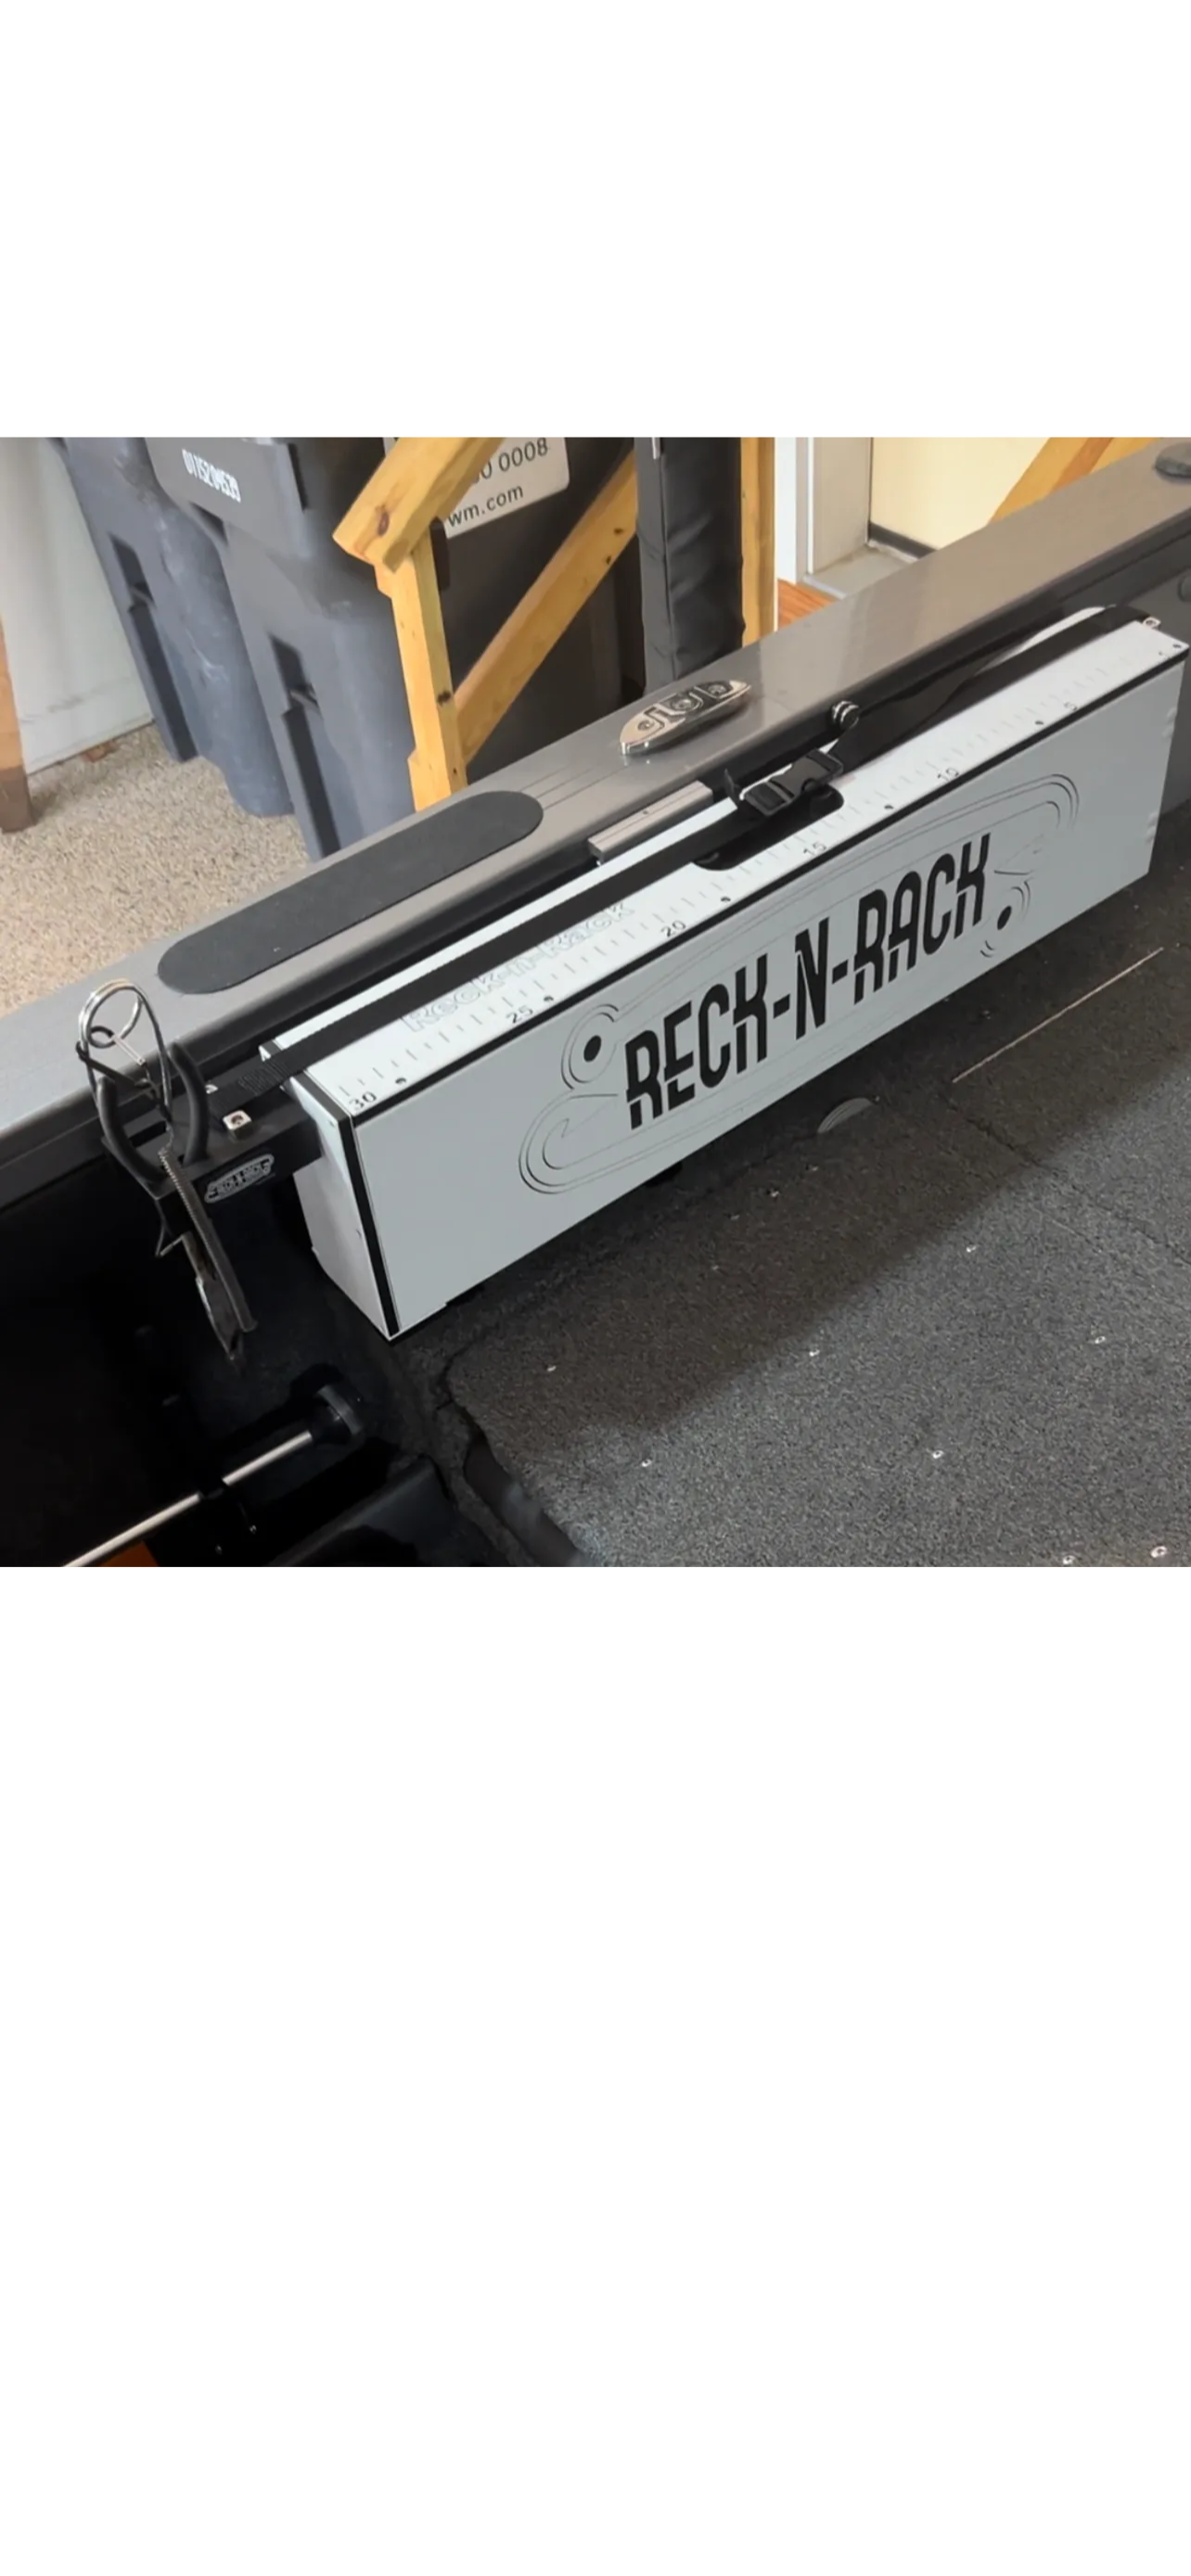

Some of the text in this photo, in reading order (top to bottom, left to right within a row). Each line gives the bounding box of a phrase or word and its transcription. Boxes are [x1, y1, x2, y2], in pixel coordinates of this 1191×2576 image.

[498, 437, 548, 472] 0008
[448, 485, 524, 528] wm.com
[937, 766, 960, 783] 10
[802, 841, 827, 859] 15
[660, 919, 686, 937] 20
[624, 833, 992, 1129] RECK-N-RACK
[506, 1004, 534, 1025] 25
[349, 1091, 378, 1111] 30
